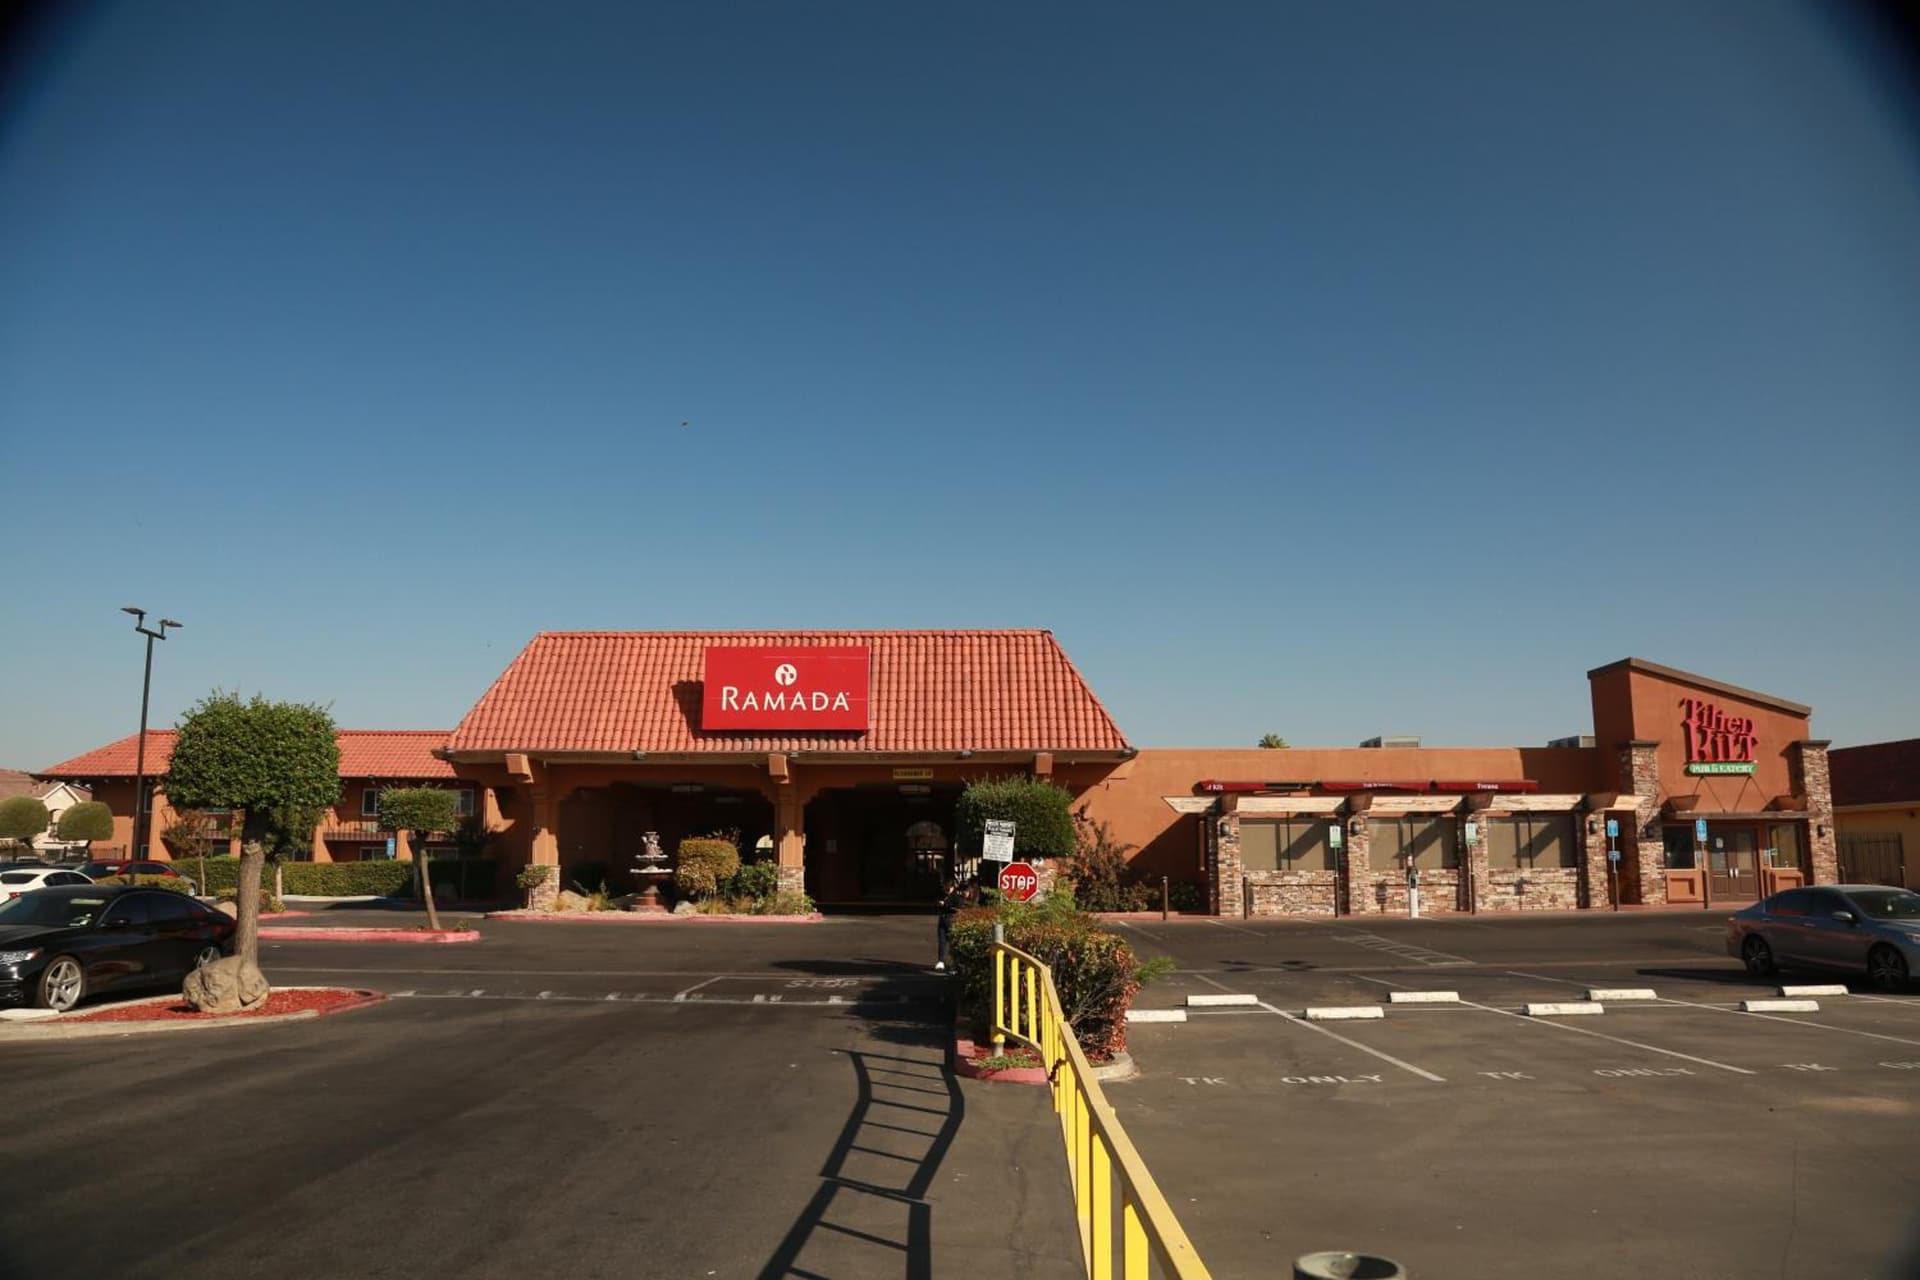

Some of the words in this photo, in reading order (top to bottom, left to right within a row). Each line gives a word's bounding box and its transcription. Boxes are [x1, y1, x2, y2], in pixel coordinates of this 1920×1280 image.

[721, 686, 850, 711] RAMADA
[1001, 875, 1036, 890] STOP
[1178, 1076, 1226, 1085] TK
[1280, 1074, 1383, 1085] ONLY
